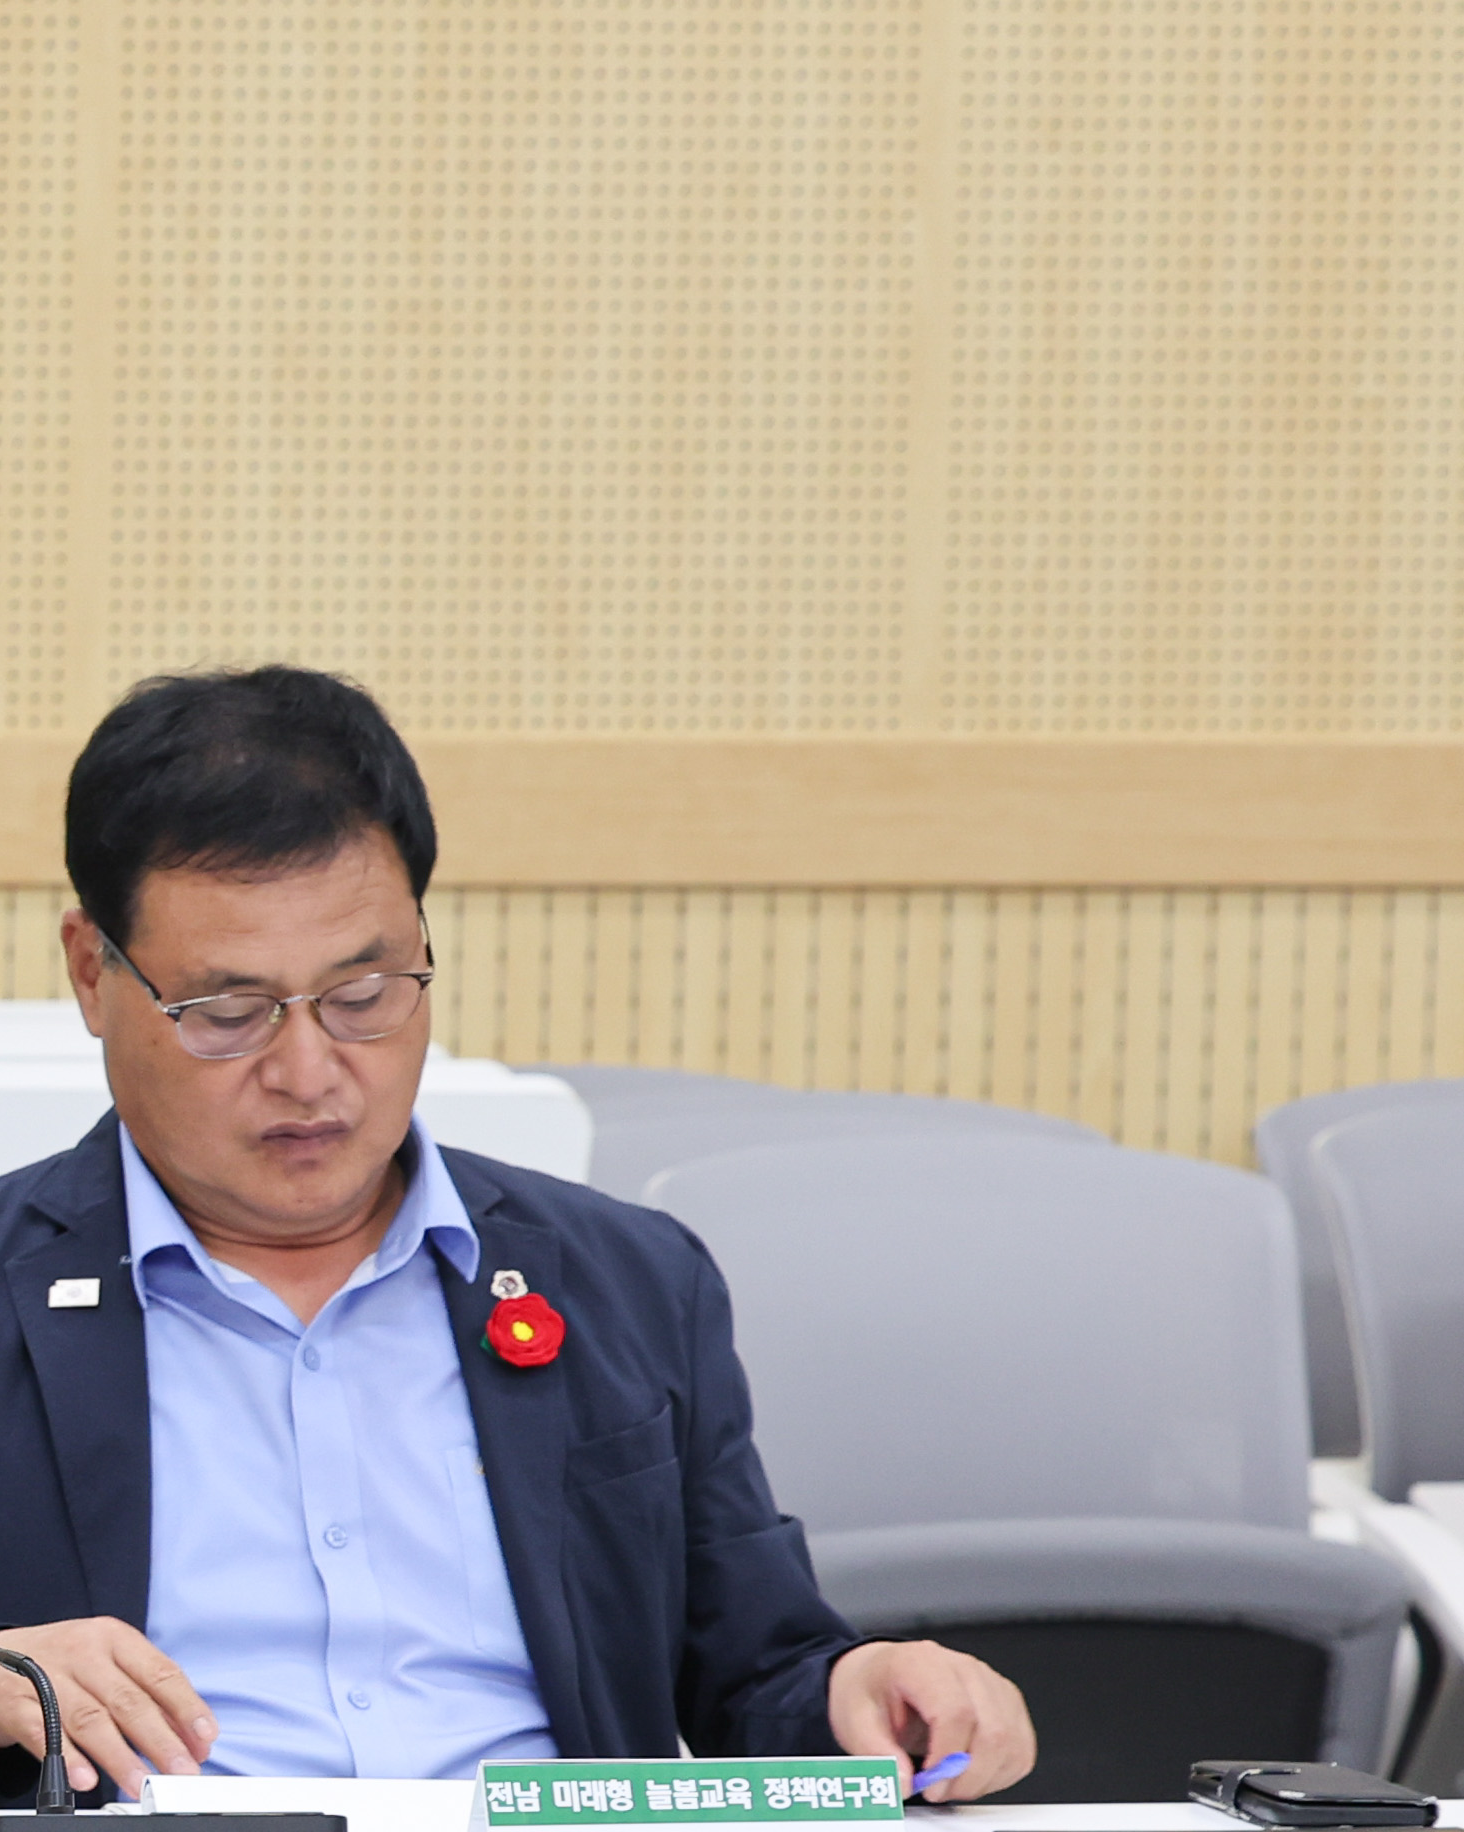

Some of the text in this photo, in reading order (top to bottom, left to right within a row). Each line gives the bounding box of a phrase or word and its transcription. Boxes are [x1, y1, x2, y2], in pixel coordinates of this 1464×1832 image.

[486, 1775, 898, 1814] 전남 미래형 늘봄교육 정책연구회
